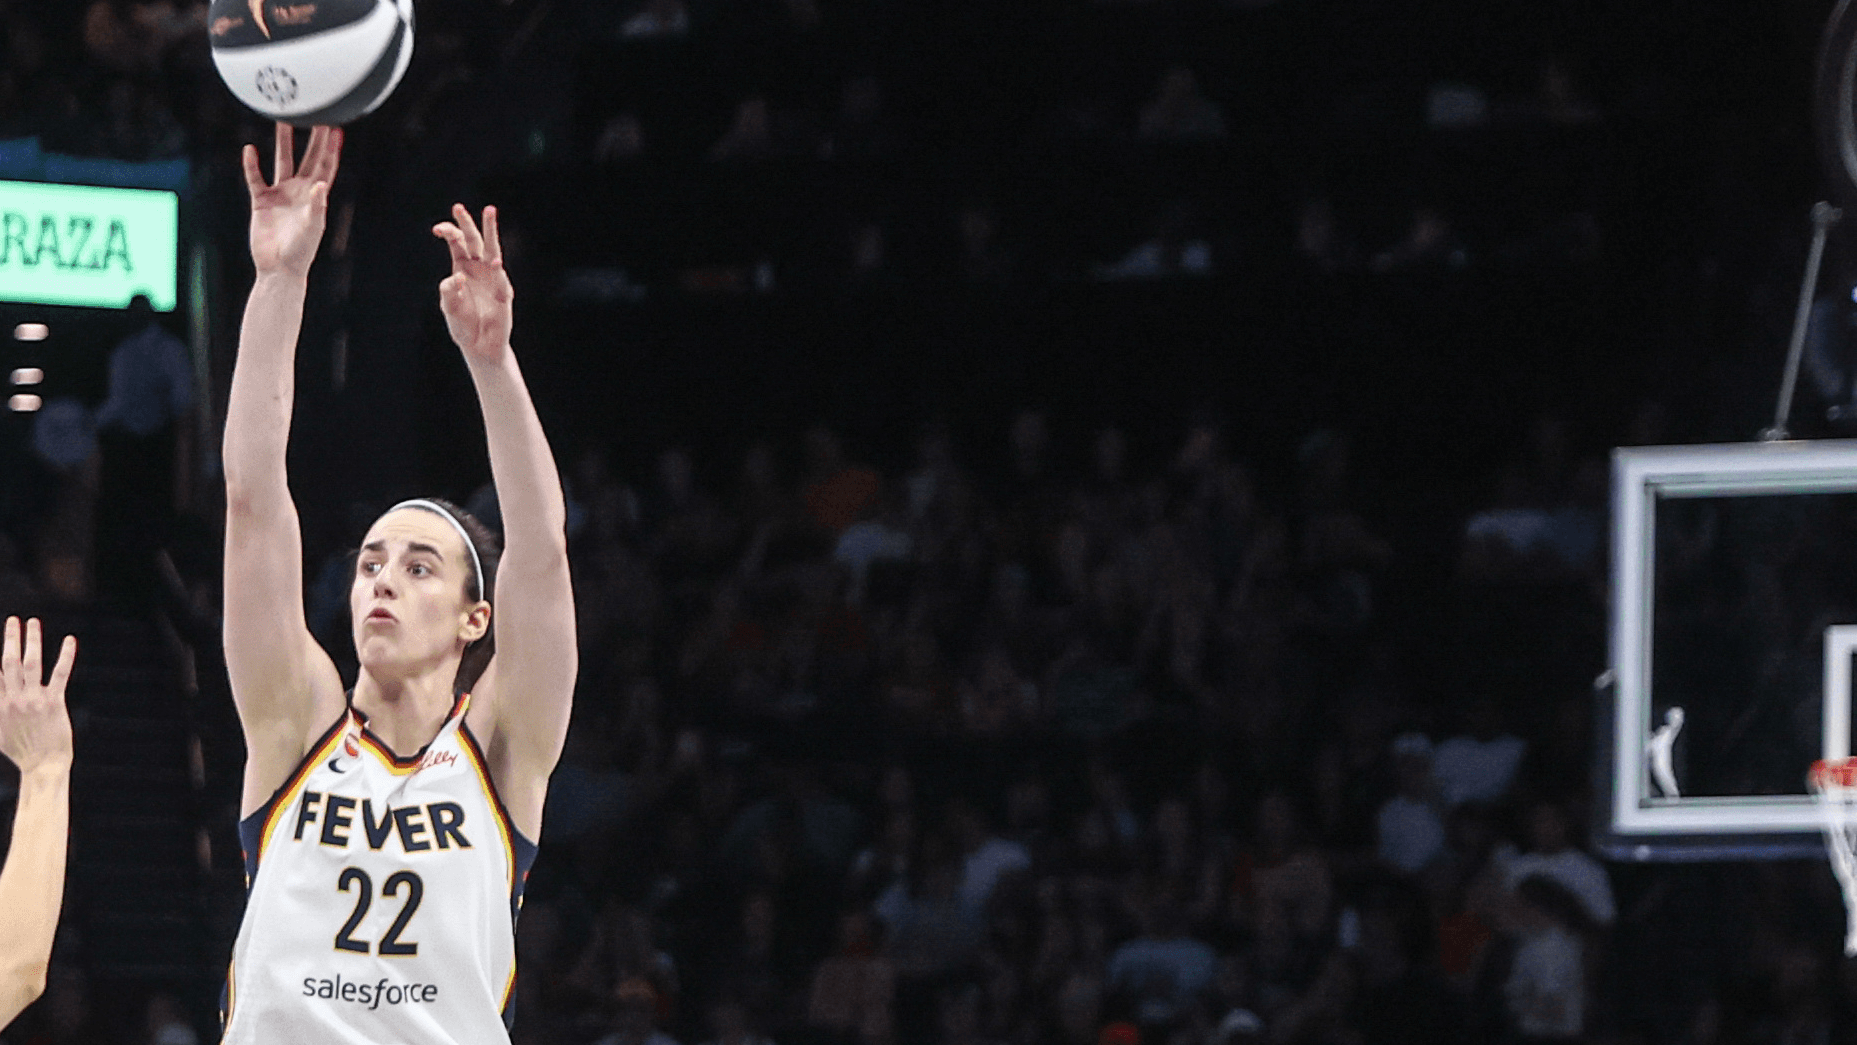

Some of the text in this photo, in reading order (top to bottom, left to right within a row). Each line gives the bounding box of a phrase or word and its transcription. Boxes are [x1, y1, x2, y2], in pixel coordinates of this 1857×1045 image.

[294, 790, 475, 852] FEVER
[334, 866, 424, 957] 22
[303, 974, 438, 1010] salesforce
